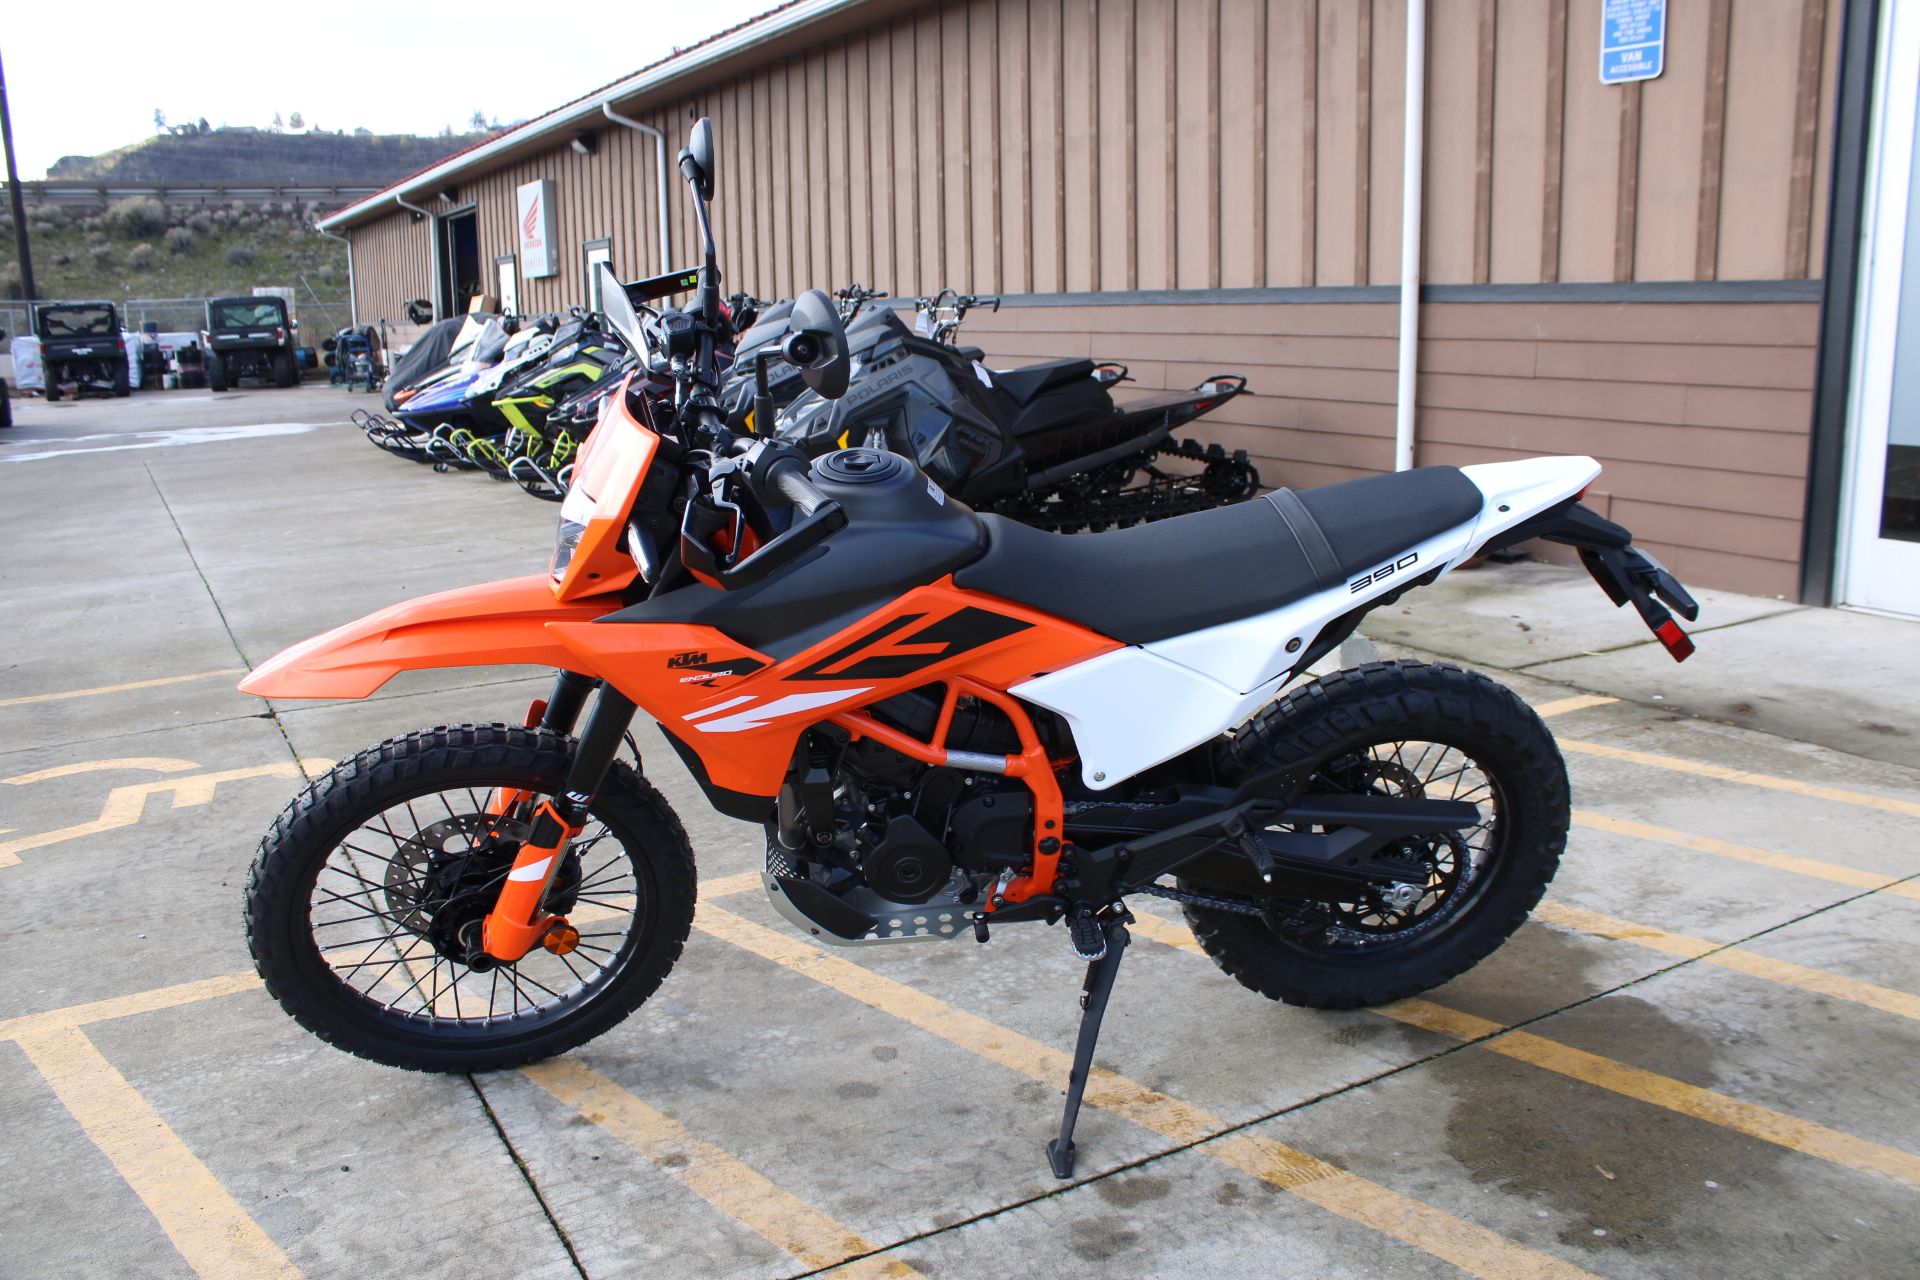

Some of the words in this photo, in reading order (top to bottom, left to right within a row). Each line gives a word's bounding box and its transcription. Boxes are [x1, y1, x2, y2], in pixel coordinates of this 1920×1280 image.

[1620, 49, 1643, 64] VAN
[1609, 60, 1653, 74] ACCESSIBLE
[523, 238, 542, 250] HONDA
[846, 364, 913, 406] POLARIS
[1350, 551, 1419, 594] 390
[667, 651, 708, 669] KTM
[679, 669, 733, 683] ENDURO
